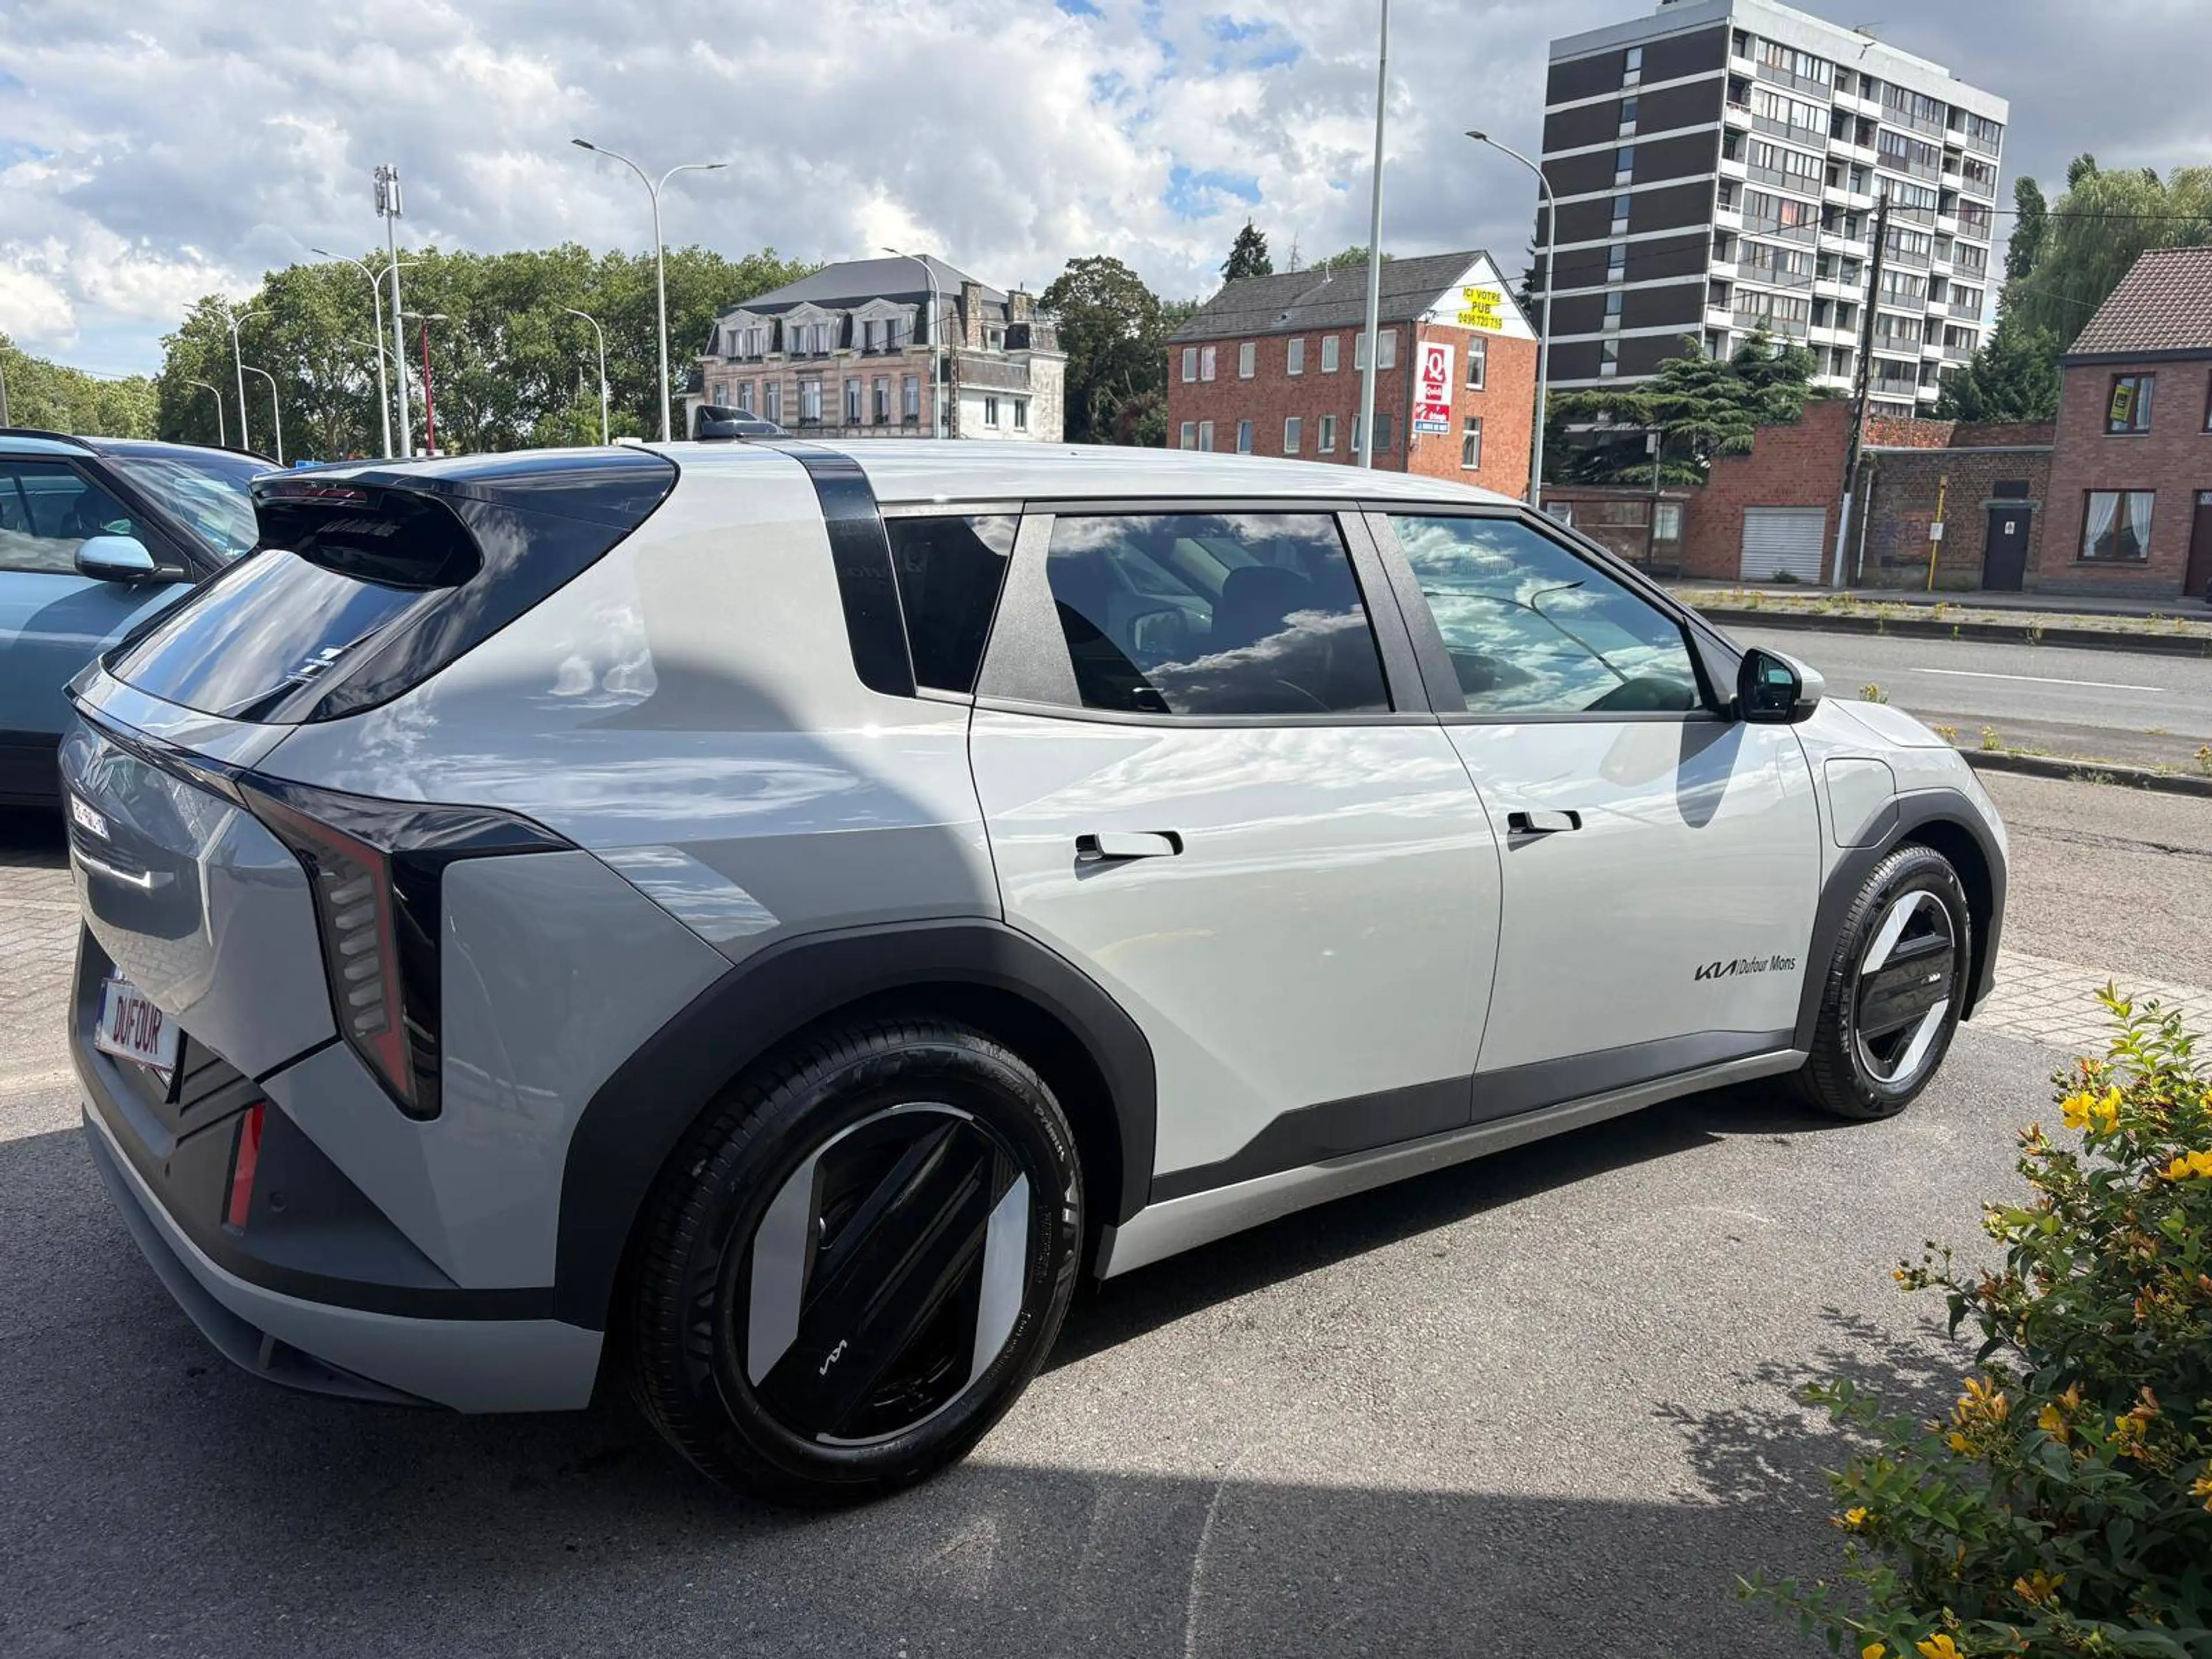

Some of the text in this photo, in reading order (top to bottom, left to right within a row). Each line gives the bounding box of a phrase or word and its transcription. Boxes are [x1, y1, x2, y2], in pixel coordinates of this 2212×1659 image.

[1463, 287, 1501, 302] ICI VOTRE
[1472, 301, 1491, 314] PUB
[1770, 955, 1796, 971] Mons
[113, 995, 163, 1055] DUFOUR
